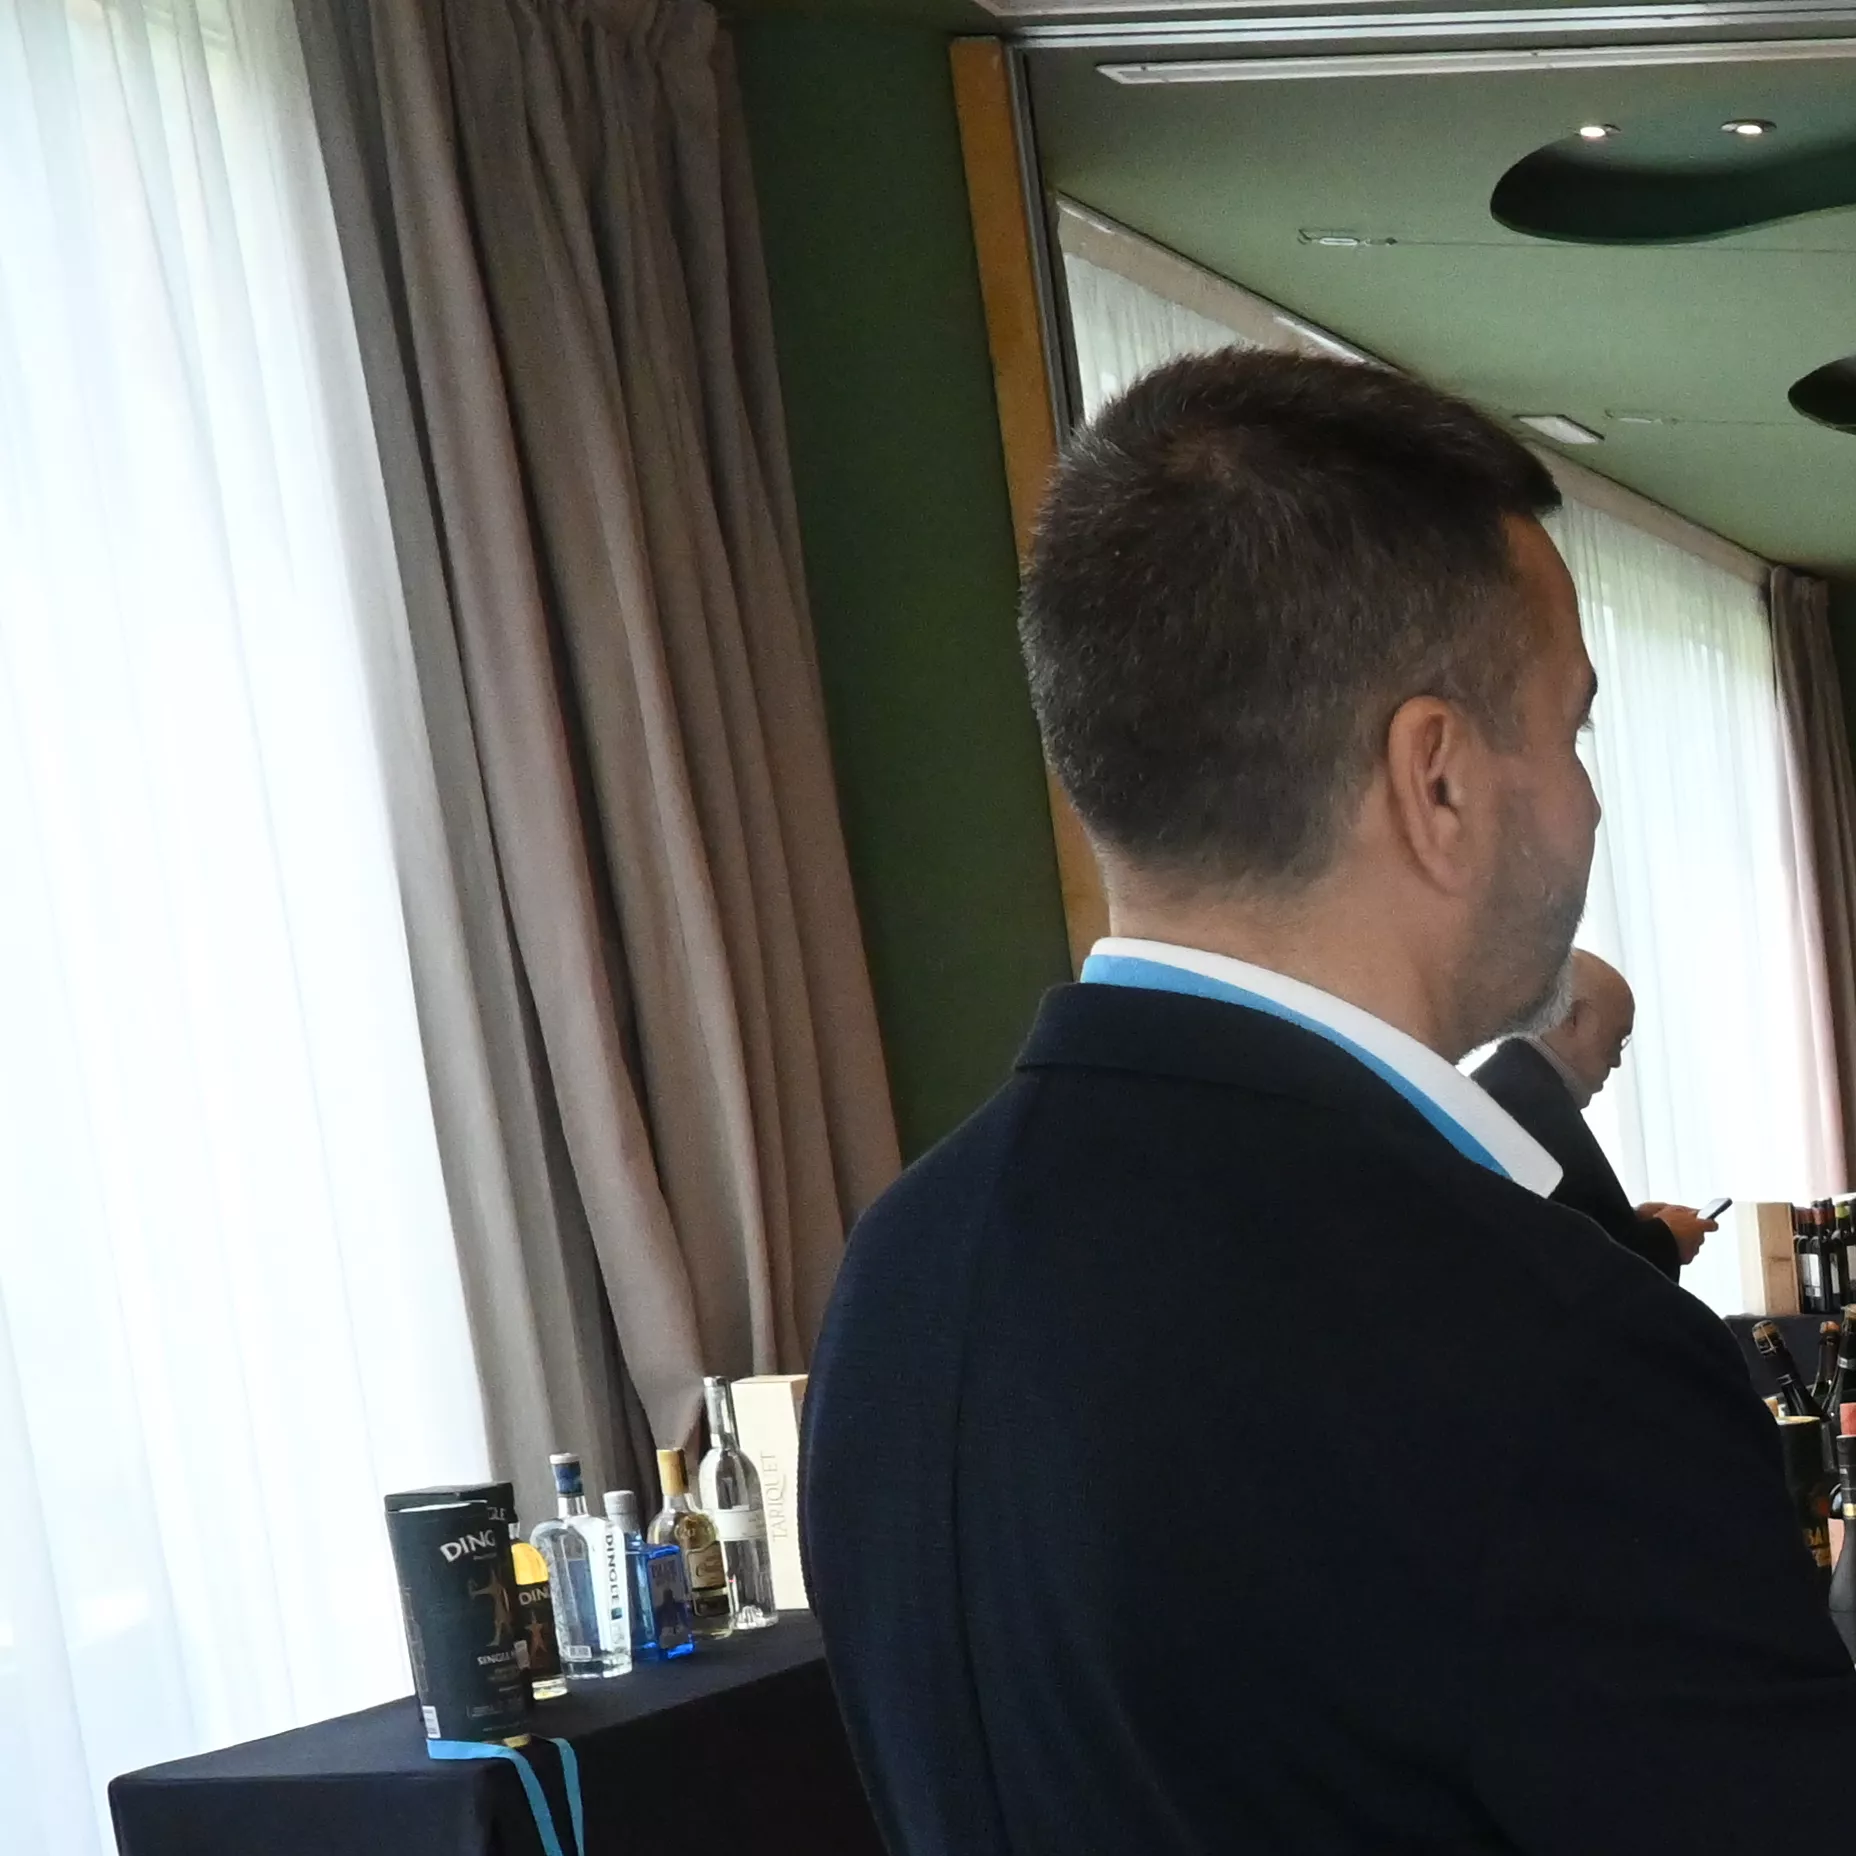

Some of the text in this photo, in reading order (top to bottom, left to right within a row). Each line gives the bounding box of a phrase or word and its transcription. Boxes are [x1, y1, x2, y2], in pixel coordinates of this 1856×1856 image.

[761, 1452, 788, 1543] TARIQUET
[440, 1529, 496, 1563] DING
[605, 1534, 620, 1601] DINGLE
